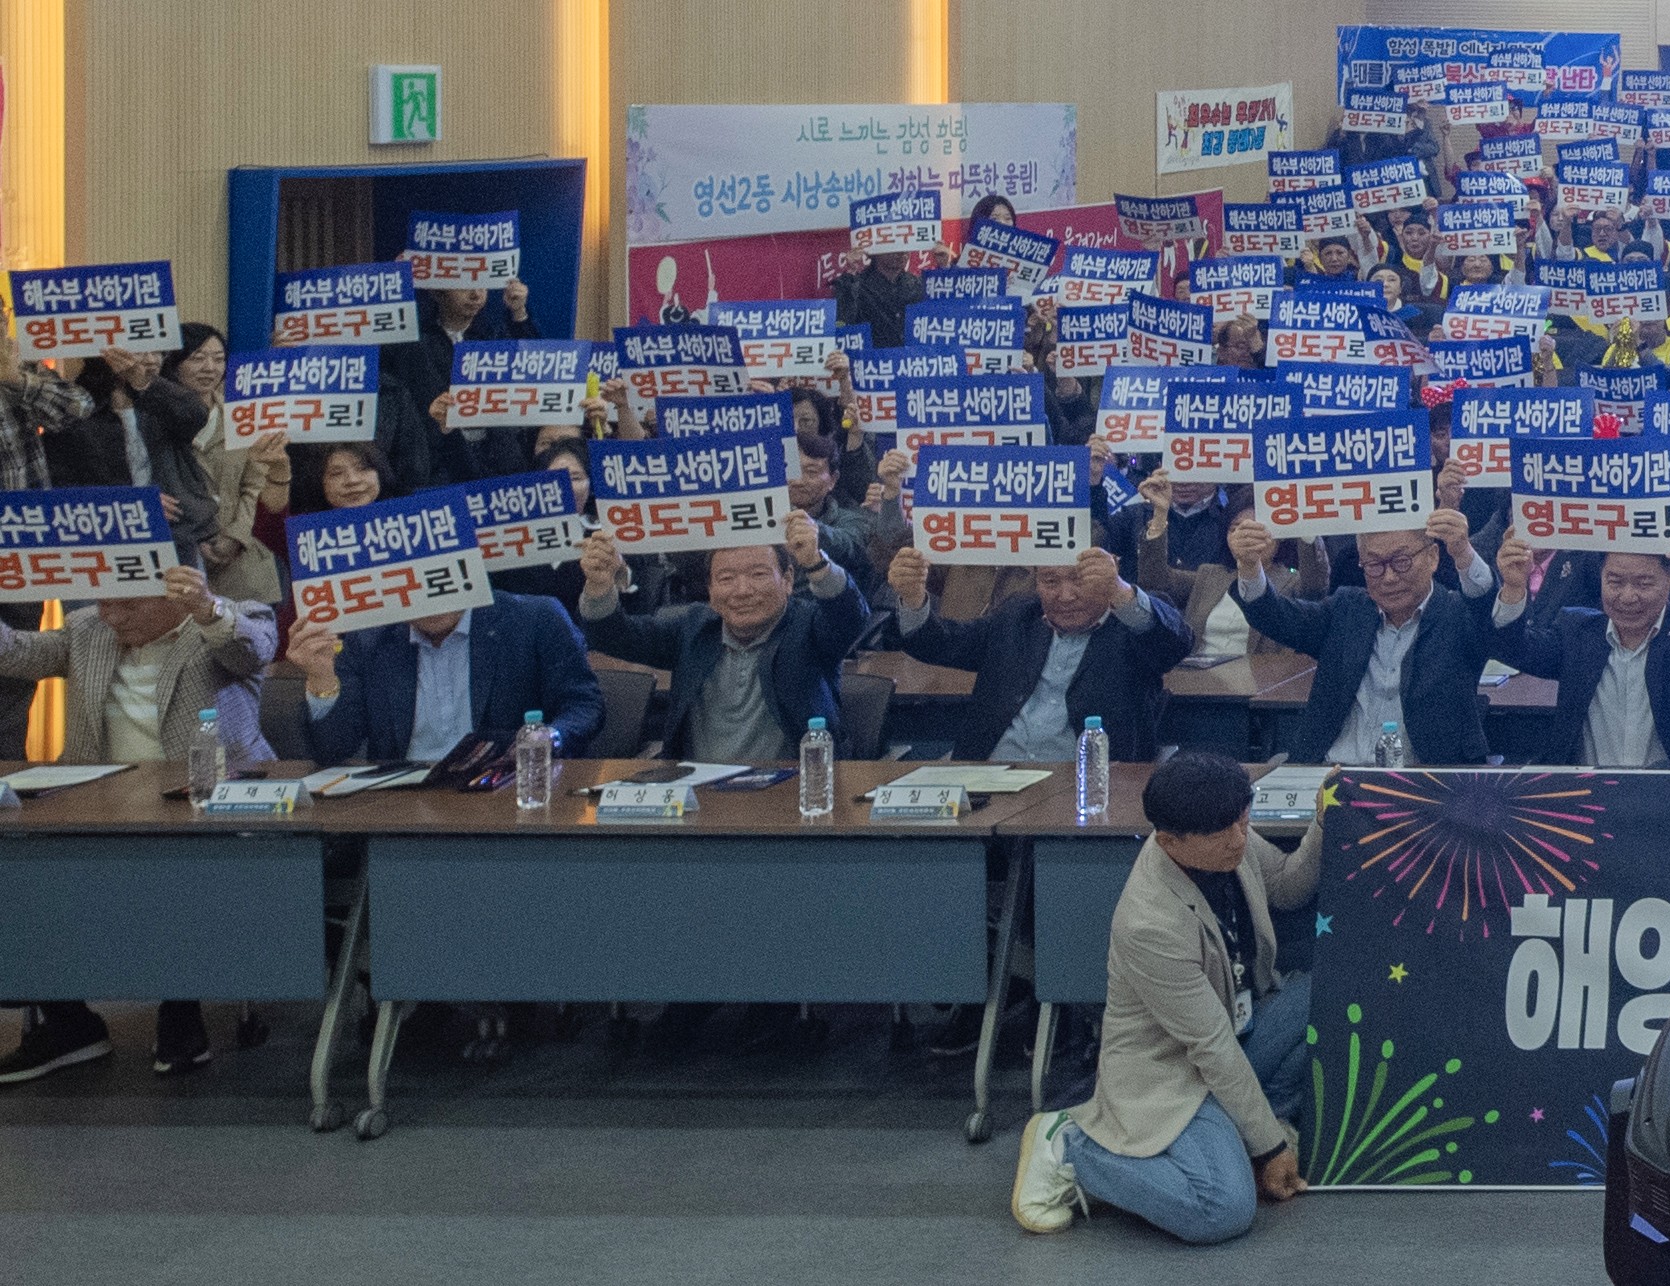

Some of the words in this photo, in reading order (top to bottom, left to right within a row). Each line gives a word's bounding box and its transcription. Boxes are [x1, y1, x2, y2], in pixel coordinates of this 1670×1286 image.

[1387, 37, 1419, 57] 함성
[1422, 38, 1456, 58] 폭발!
[1561, 64, 1597, 92] 난타
[796, 116, 833, 142] 시로
[838, 117, 891, 155] 느끼는
[896, 114, 931, 155] 감성
[935, 114, 969, 155] 힐링
[693, 177, 773, 218] 영선2동
[782, 168, 882, 210] 시낭송반이
[948, 162, 999, 197] 따뜻한
[1003, 161, 1039, 194] 울림!
[1228, 210, 1258, 230] 해수부
[1257, 209, 1296, 230] 산하기관
[1229, 233, 1299, 252] 영도구로!
[24, 278, 82, 311] 해수부
[83, 272, 160, 308] 산하기관
[284, 278, 333, 308] 해수부
[335, 270, 402, 304] 산하기관
[24, 313, 167, 349] 영도구로!
[283, 307, 406, 341] 영도구로!
[233, 361, 286, 395] 해수부
[289, 354, 366, 392] 산하기관
[228, 399, 364, 433] 영도구로!
[602, 453, 671, 495] 해수부
[674, 443, 768, 490] 산하기관
[1265, 431, 1328, 475] 해수부
[1331, 425, 1415, 471] 산하기관
[927, 459, 989, 502] 해수부
[992, 460, 1075, 502] 산하기관
[1523, 451, 1584, 492] 해수부
[606, 497, 777, 541] 영도구로!
[1264, 479, 1420, 524] 영도구로!
[293, 524, 362, 572] 해수부
[363, 504, 458, 561] 산하기관
[923, 512, 1075, 552] 영도구로!
[300, 558, 473, 621] 영도구로!
